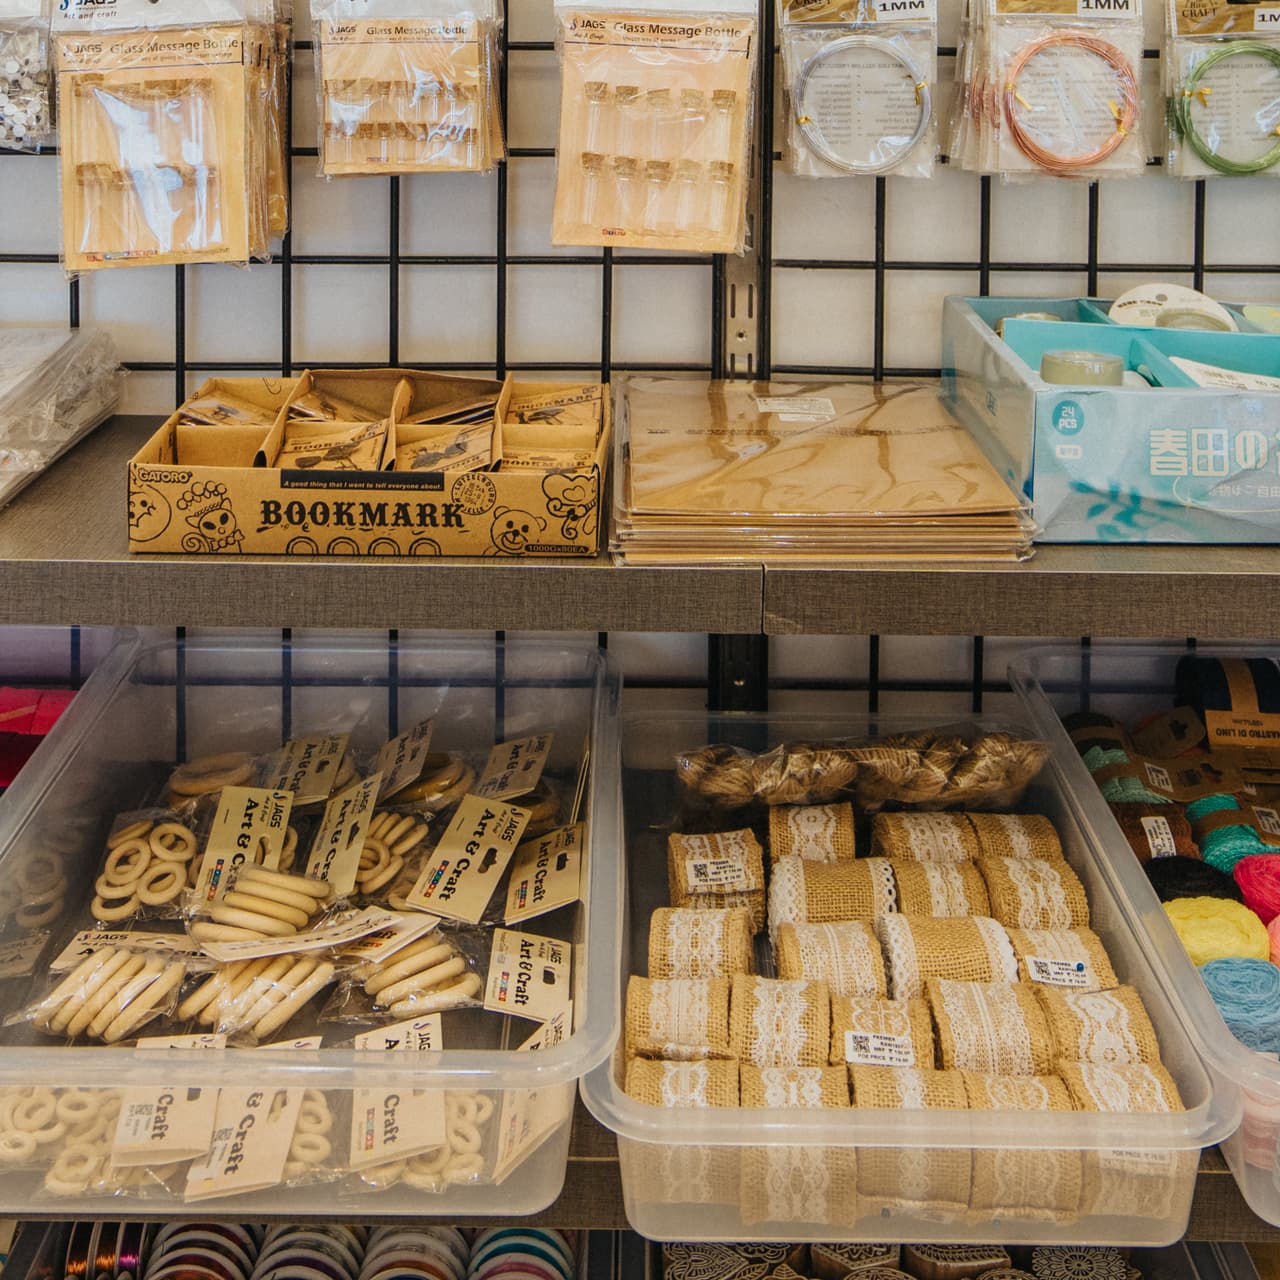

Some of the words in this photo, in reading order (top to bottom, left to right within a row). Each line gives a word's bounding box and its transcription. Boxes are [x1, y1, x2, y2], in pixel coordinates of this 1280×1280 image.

[879, 0, 925, 12] 1MM
[1182, 8, 1218, 18] CRAFT
[367, 25, 392, 35] Glass
[394, 25, 436, 37] Message
[614, 21, 645, 34] Glass
[649, 24, 701, 38] Message
[705, 26, 741, 38] Bottle
[146, 40, 200, 54] Message
[203, 39, 239, 50] Bottle
[1061, 406, 1075, 417] 24
[1058, 418, 1077, 429] PCS
[138, 470, 191, 484] GATORO
[309, 481, 329, 489] thing
[260, 500, 466, 530] BOOKMARK
[243, 797, 260, 830] Art
[270, 803, 286, 829] JAGS
[338, 799, 354, 830] Art
[472, 807, 496, 839] Art
[501, 818, 520, 842] JAGS
[465, 839, 481, 856] &
[438, 857, 471, 902] Craft
[532, 866, 549, 903] Craft
[520, 938, 535, 960] Art
[518, 960, 533, 972] &
[514, 972, 532, 1006] Craft
[150, 1093, 174, 1141] Craft
[382, 1094, 401, 1145] Craft
[224, 1113, 256, 1176] Craft
